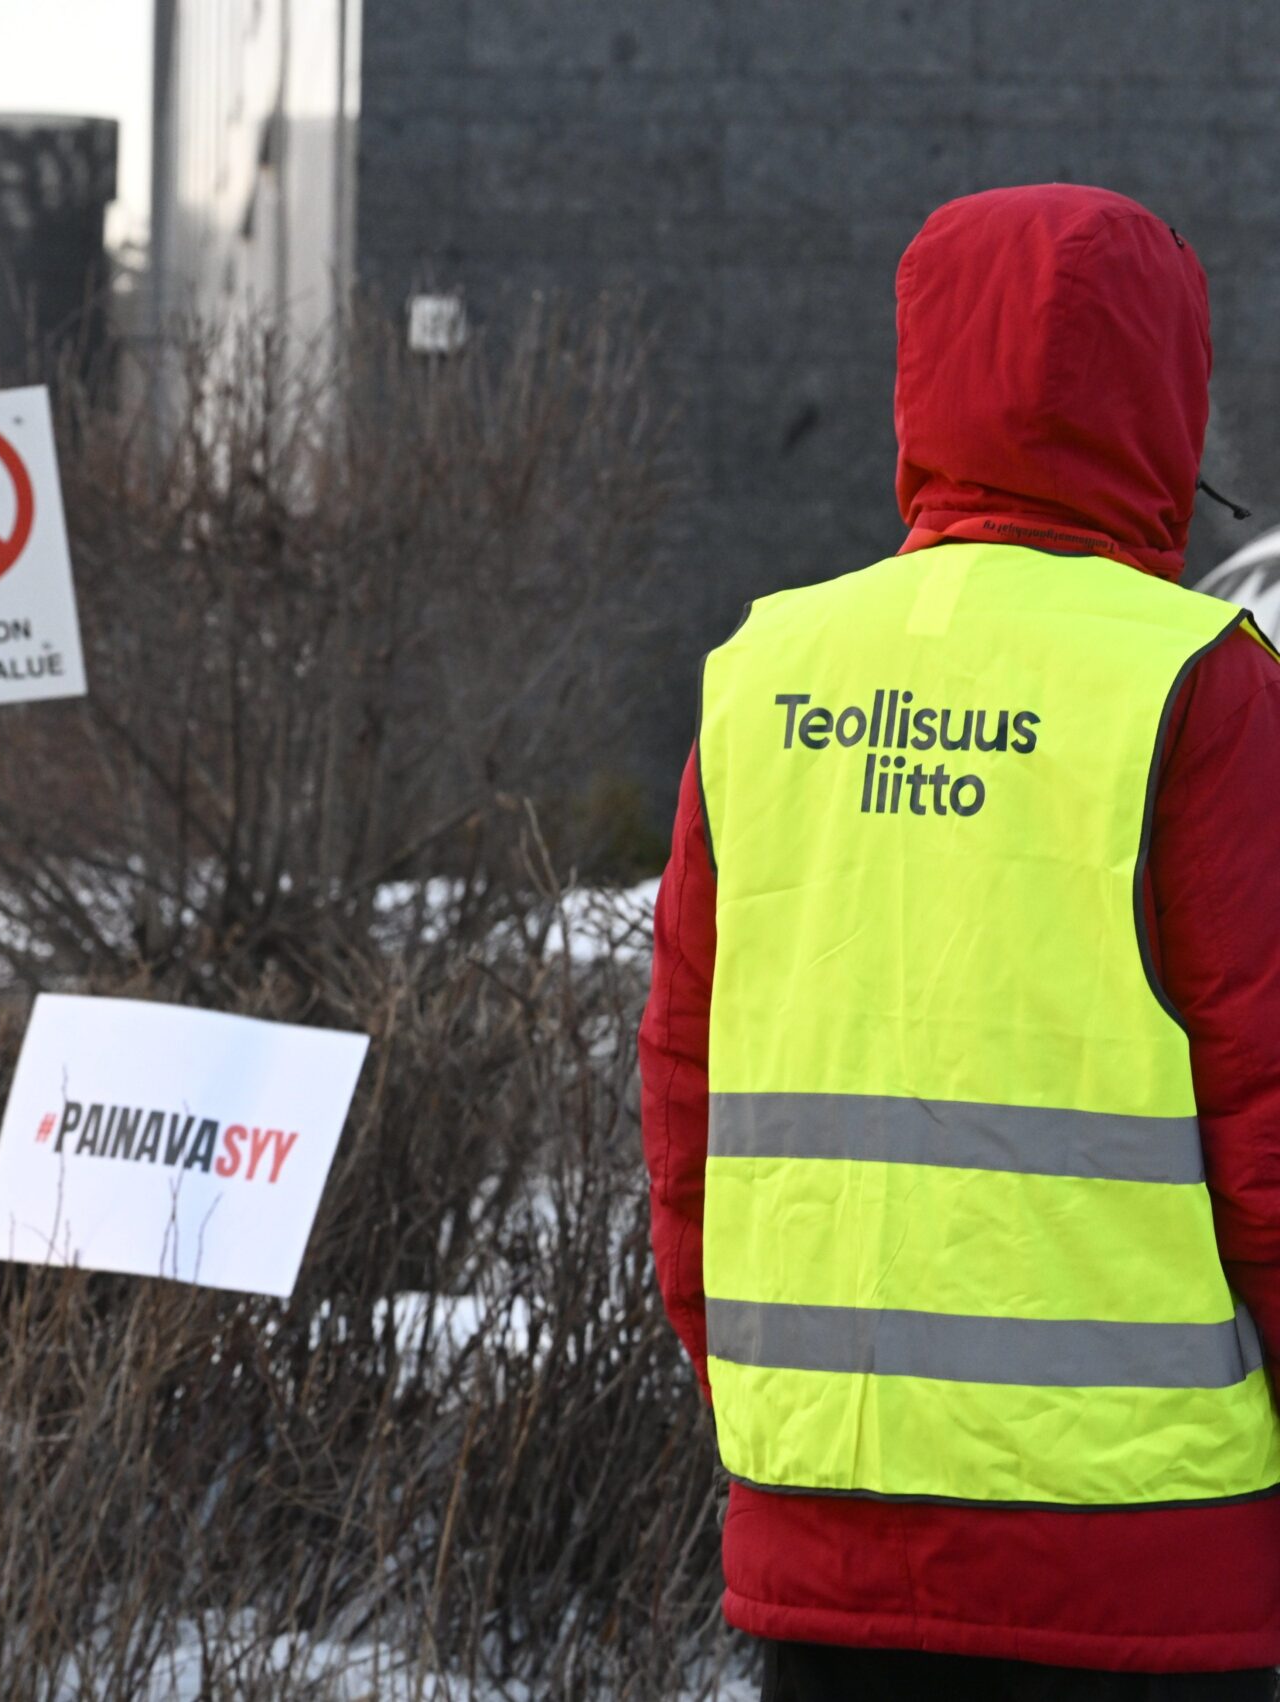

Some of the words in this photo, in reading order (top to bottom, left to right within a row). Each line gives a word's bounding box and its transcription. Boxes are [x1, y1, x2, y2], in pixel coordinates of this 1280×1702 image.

[774, 689, 1041, 754] Teollisuus
[861, 753, 986, 817] liitto
[35, 1100, 298, 1184] #PAINAVASYY
